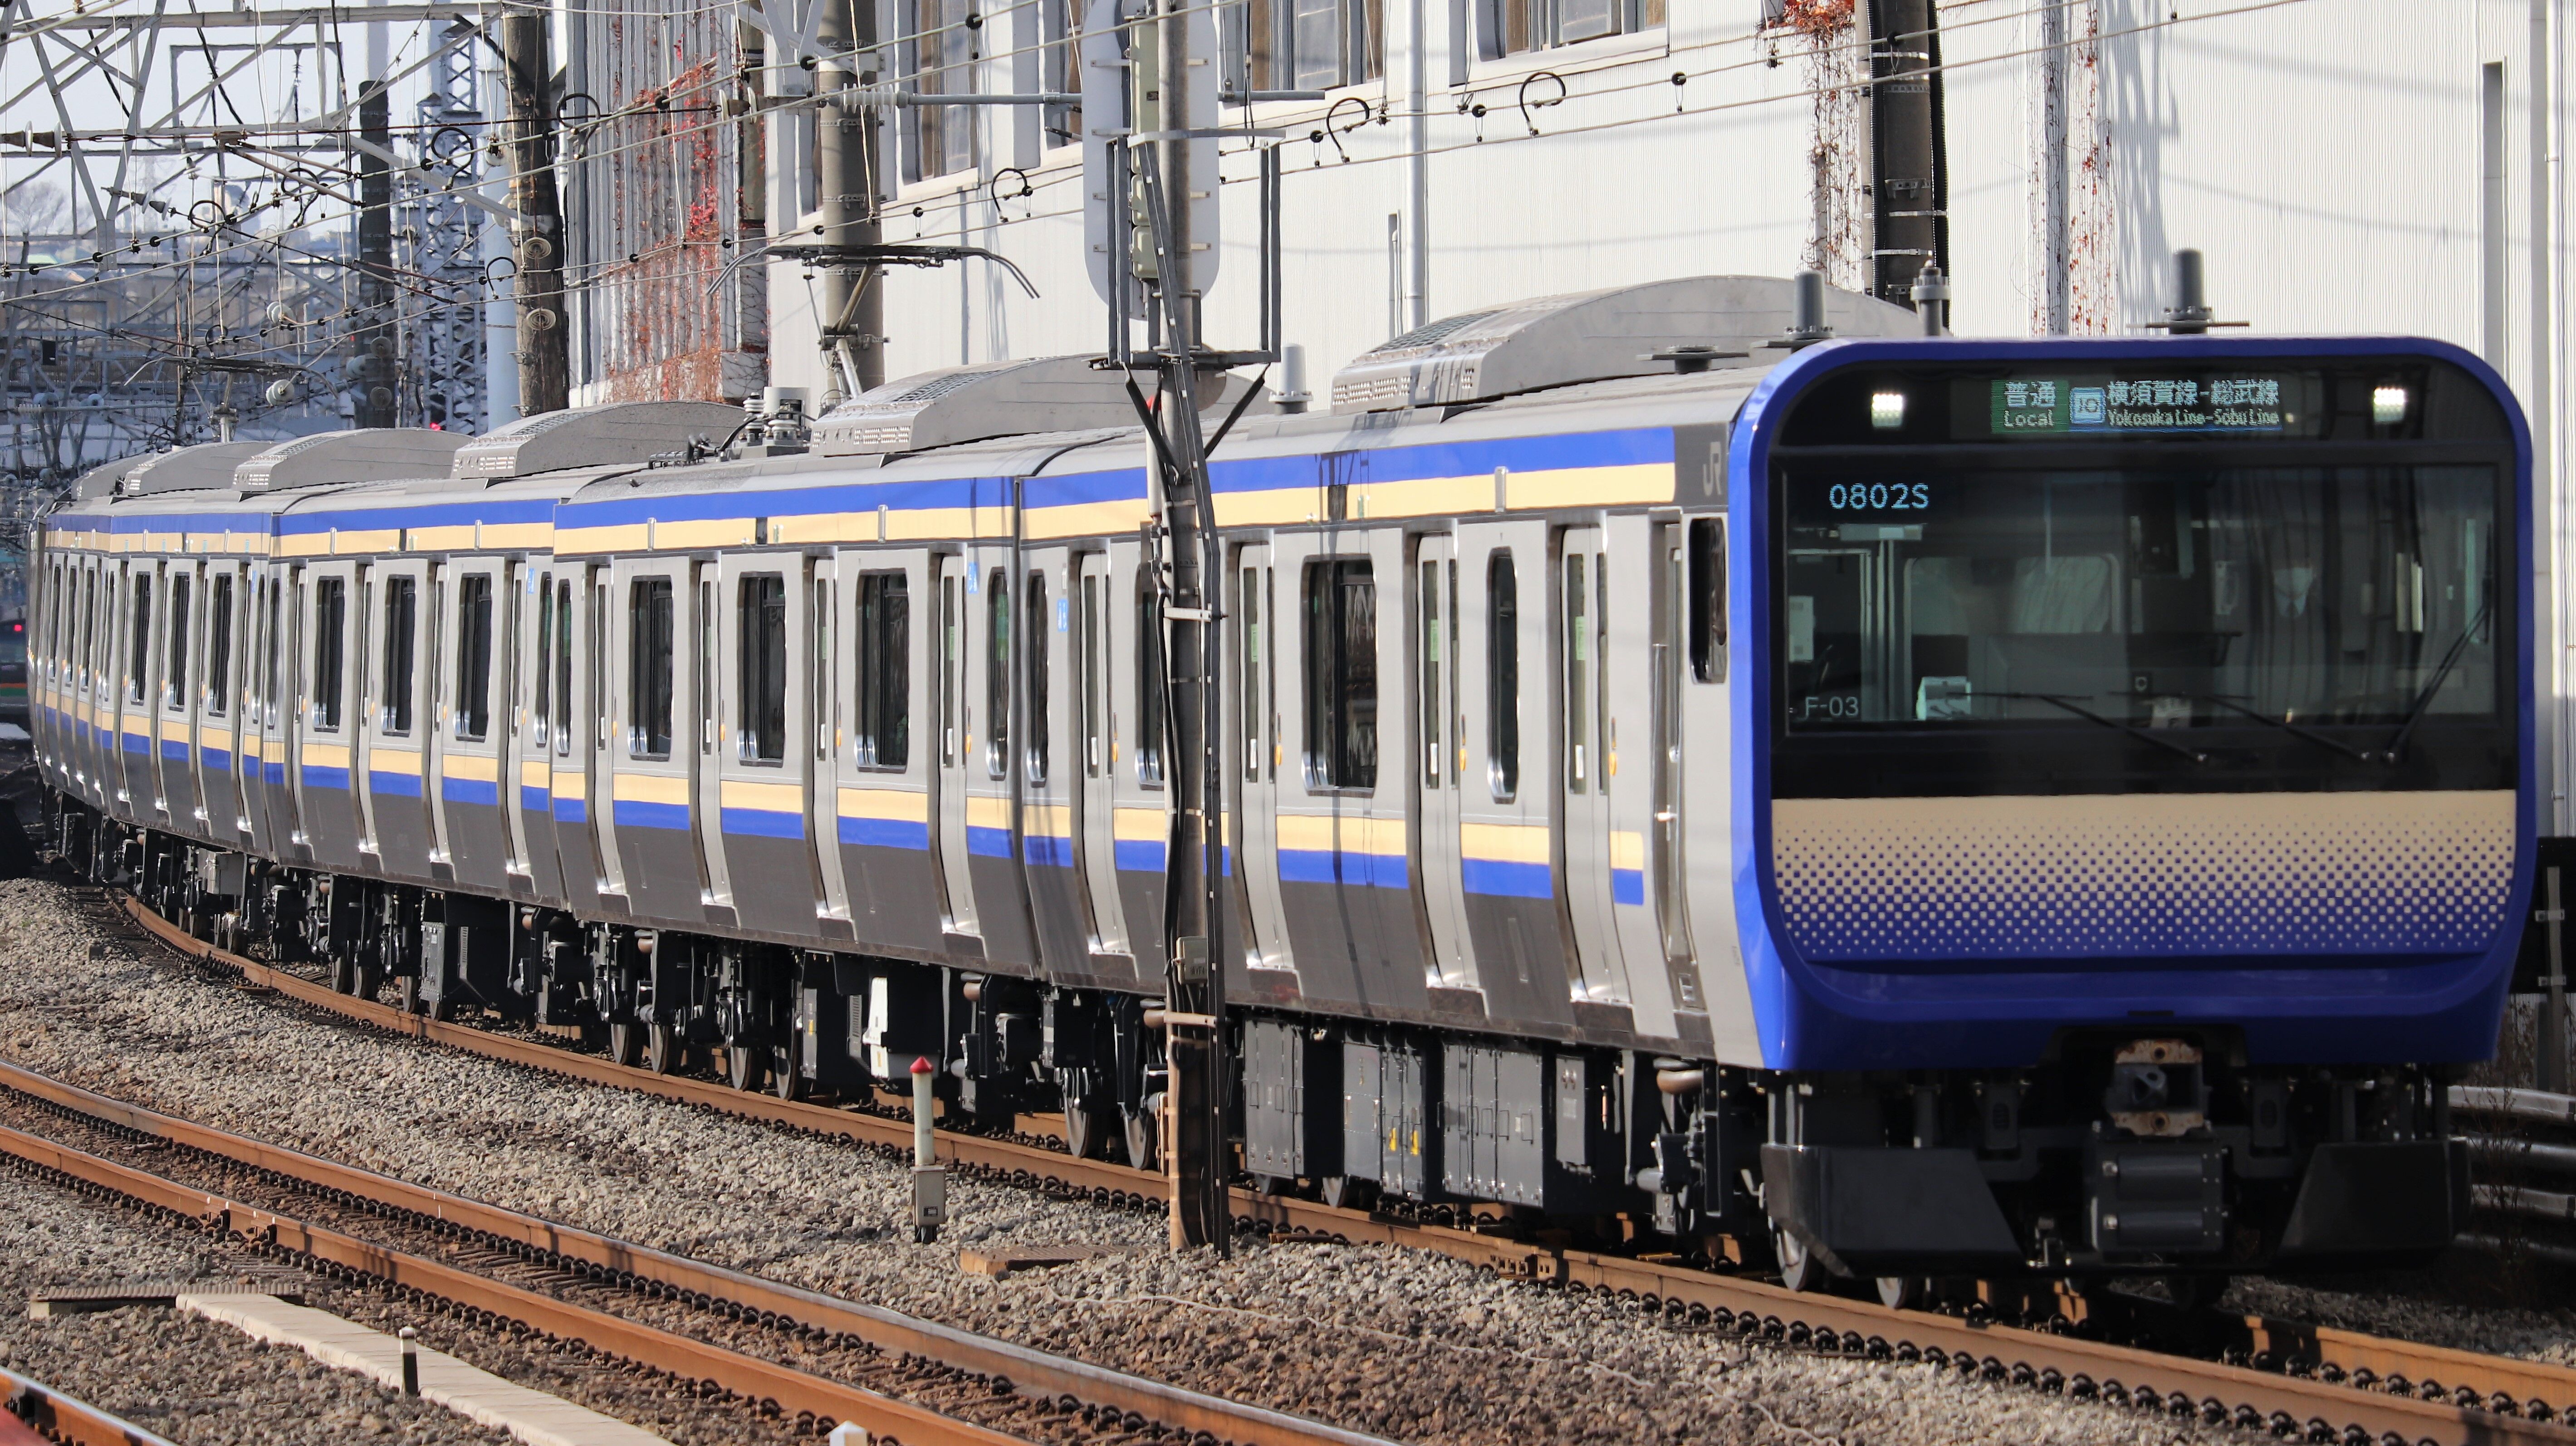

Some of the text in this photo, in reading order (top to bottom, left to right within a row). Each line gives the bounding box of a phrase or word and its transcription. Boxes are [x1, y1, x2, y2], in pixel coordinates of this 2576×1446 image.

[2004, 381, 2056, 407] 普通
[2003, 409, 2054, 426] Local
[1703, 441, 1722, 497] JR
[1829, 483, 1929, 509] 0802S
[1804, 696, 1860, 719] F-03
